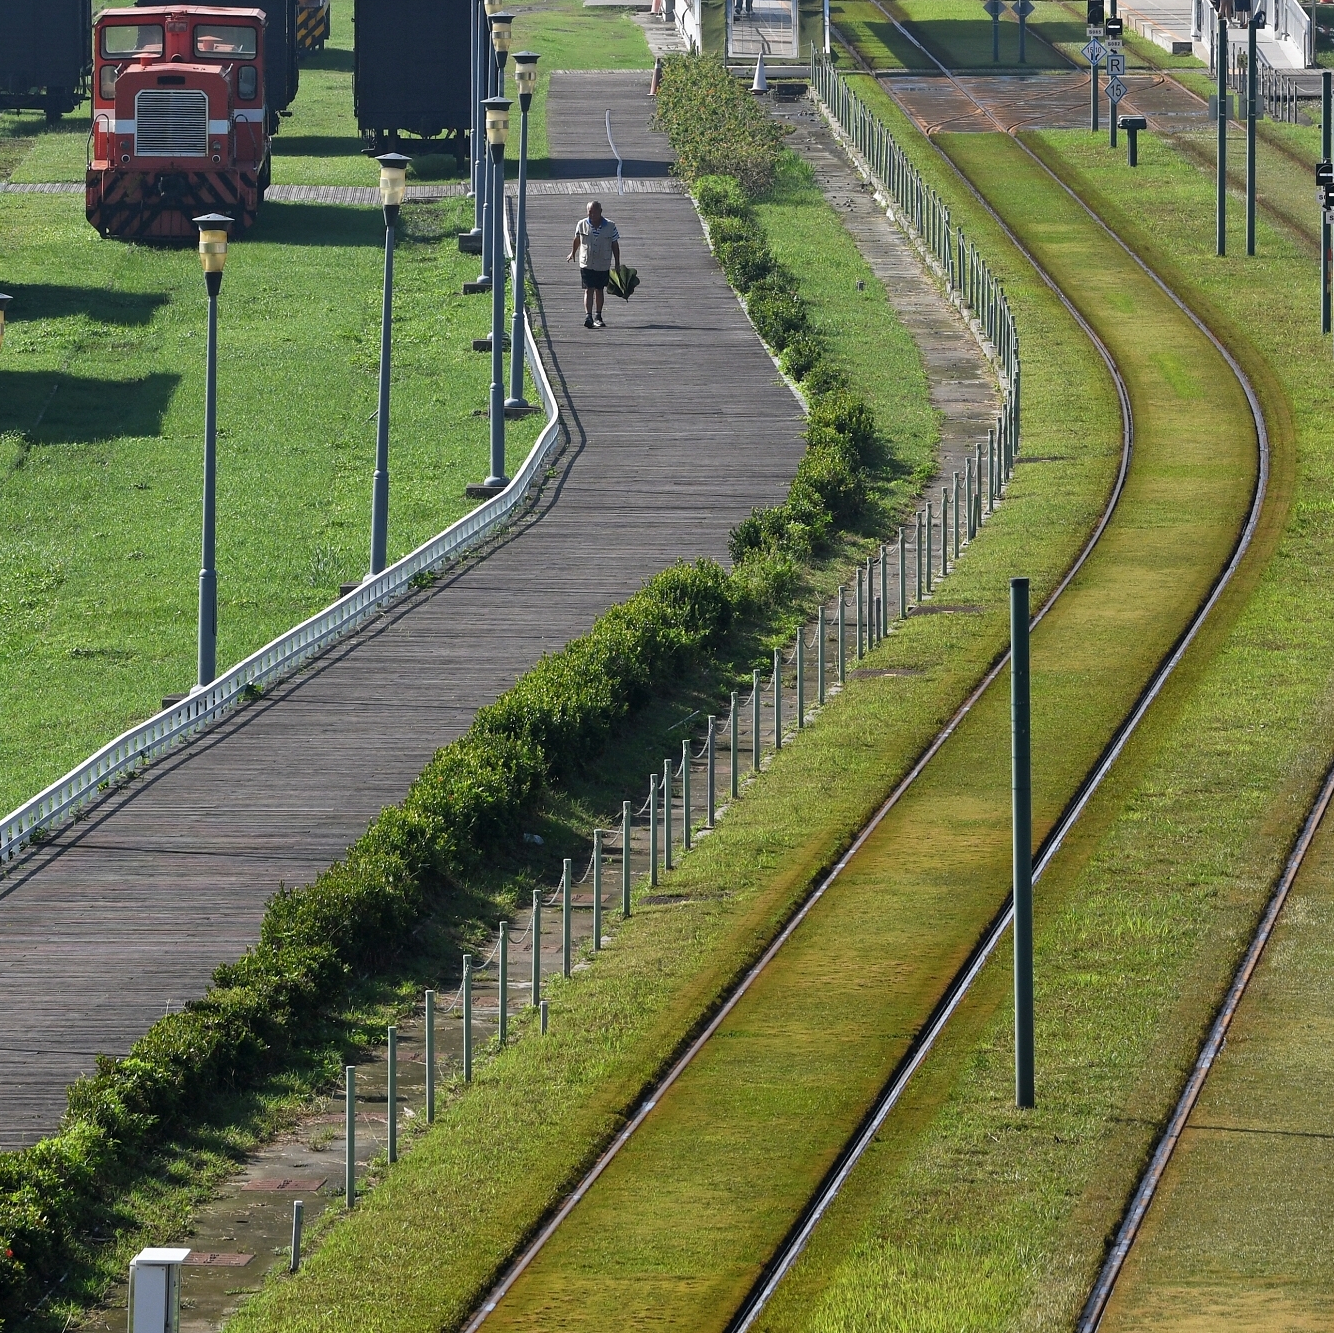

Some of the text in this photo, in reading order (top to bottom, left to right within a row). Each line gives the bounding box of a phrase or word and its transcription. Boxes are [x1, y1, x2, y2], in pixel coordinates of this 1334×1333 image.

[1087, 46, 1102, 54] 15 10
[1110, 58, 1120, 72] R
[1110, 84, 1122, 97] 15
